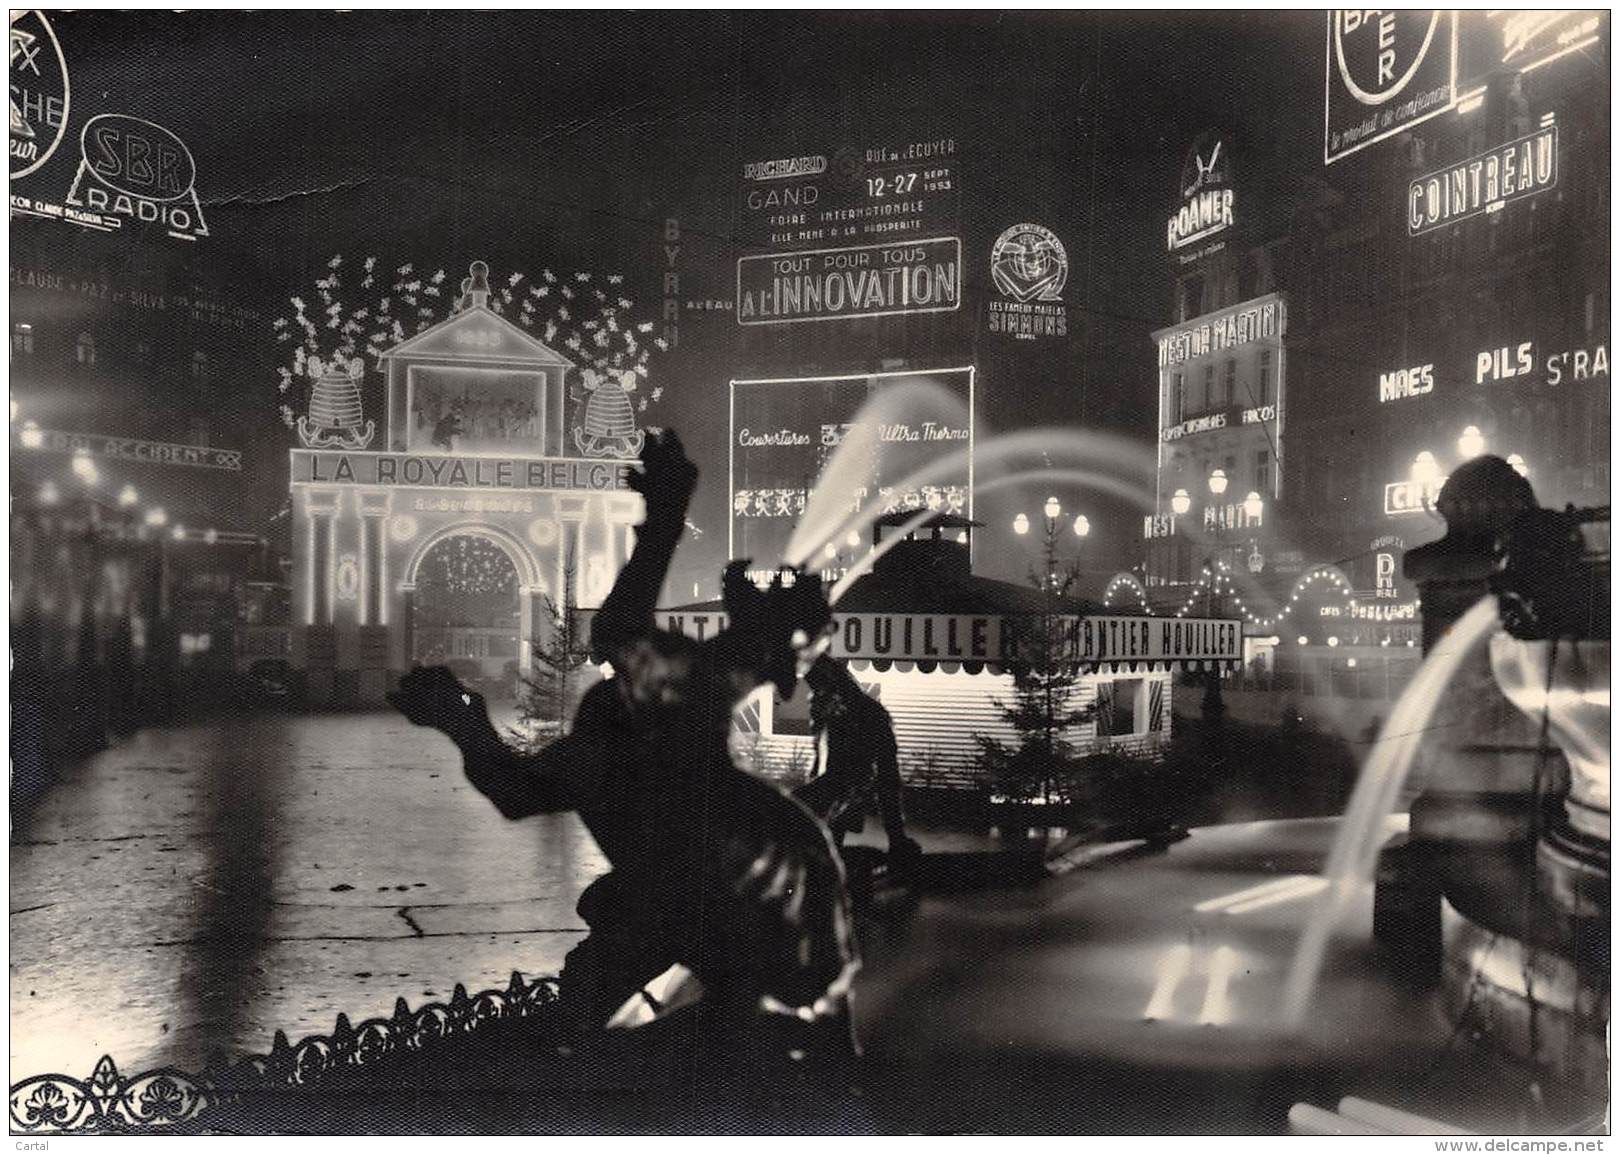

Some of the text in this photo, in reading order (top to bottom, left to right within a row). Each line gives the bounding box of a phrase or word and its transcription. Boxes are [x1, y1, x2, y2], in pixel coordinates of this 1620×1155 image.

[95, 126, 180, 193] SBR
[743, 154, 828, 180] RICHARD
[866, 147, 887, 162] RUE
[866, 173, 918, 197] 12-27
[924, 168, 950, 178] SEPT
[924, 181, 952, 191] 1953
[1410, 133, 1553, 229] COINTREAU
[88, 188, 191, 230] RADIO
[747, 185, 819, 210] GAND
[770, 200, 924, 226] FOIRE INTERNATIONALE
[1167, 189, 1234, 251] ROAMER
[771, 232, 793, 243] ELLE
[773, 246, 927, 275] TOUT POUR TOUS
[989, 301, 1003, 312] LES
[989, 312, 1067, 337] SIMMONS
[1159, 303, 1276, 366] NESTOR MARTIN
[1476, 342, 1532, 384] PILS
[1379, 364, 1434, 403] MAES
[738, 428, 811, 446] Couvertures
[879, 422, 920, 442] Ultra
[920, 421, 970, 442] Thermo
[310, 456, 631, 491] LA ROYALE BELGE
[1162, 620, 1235, 656] HOUILLER
